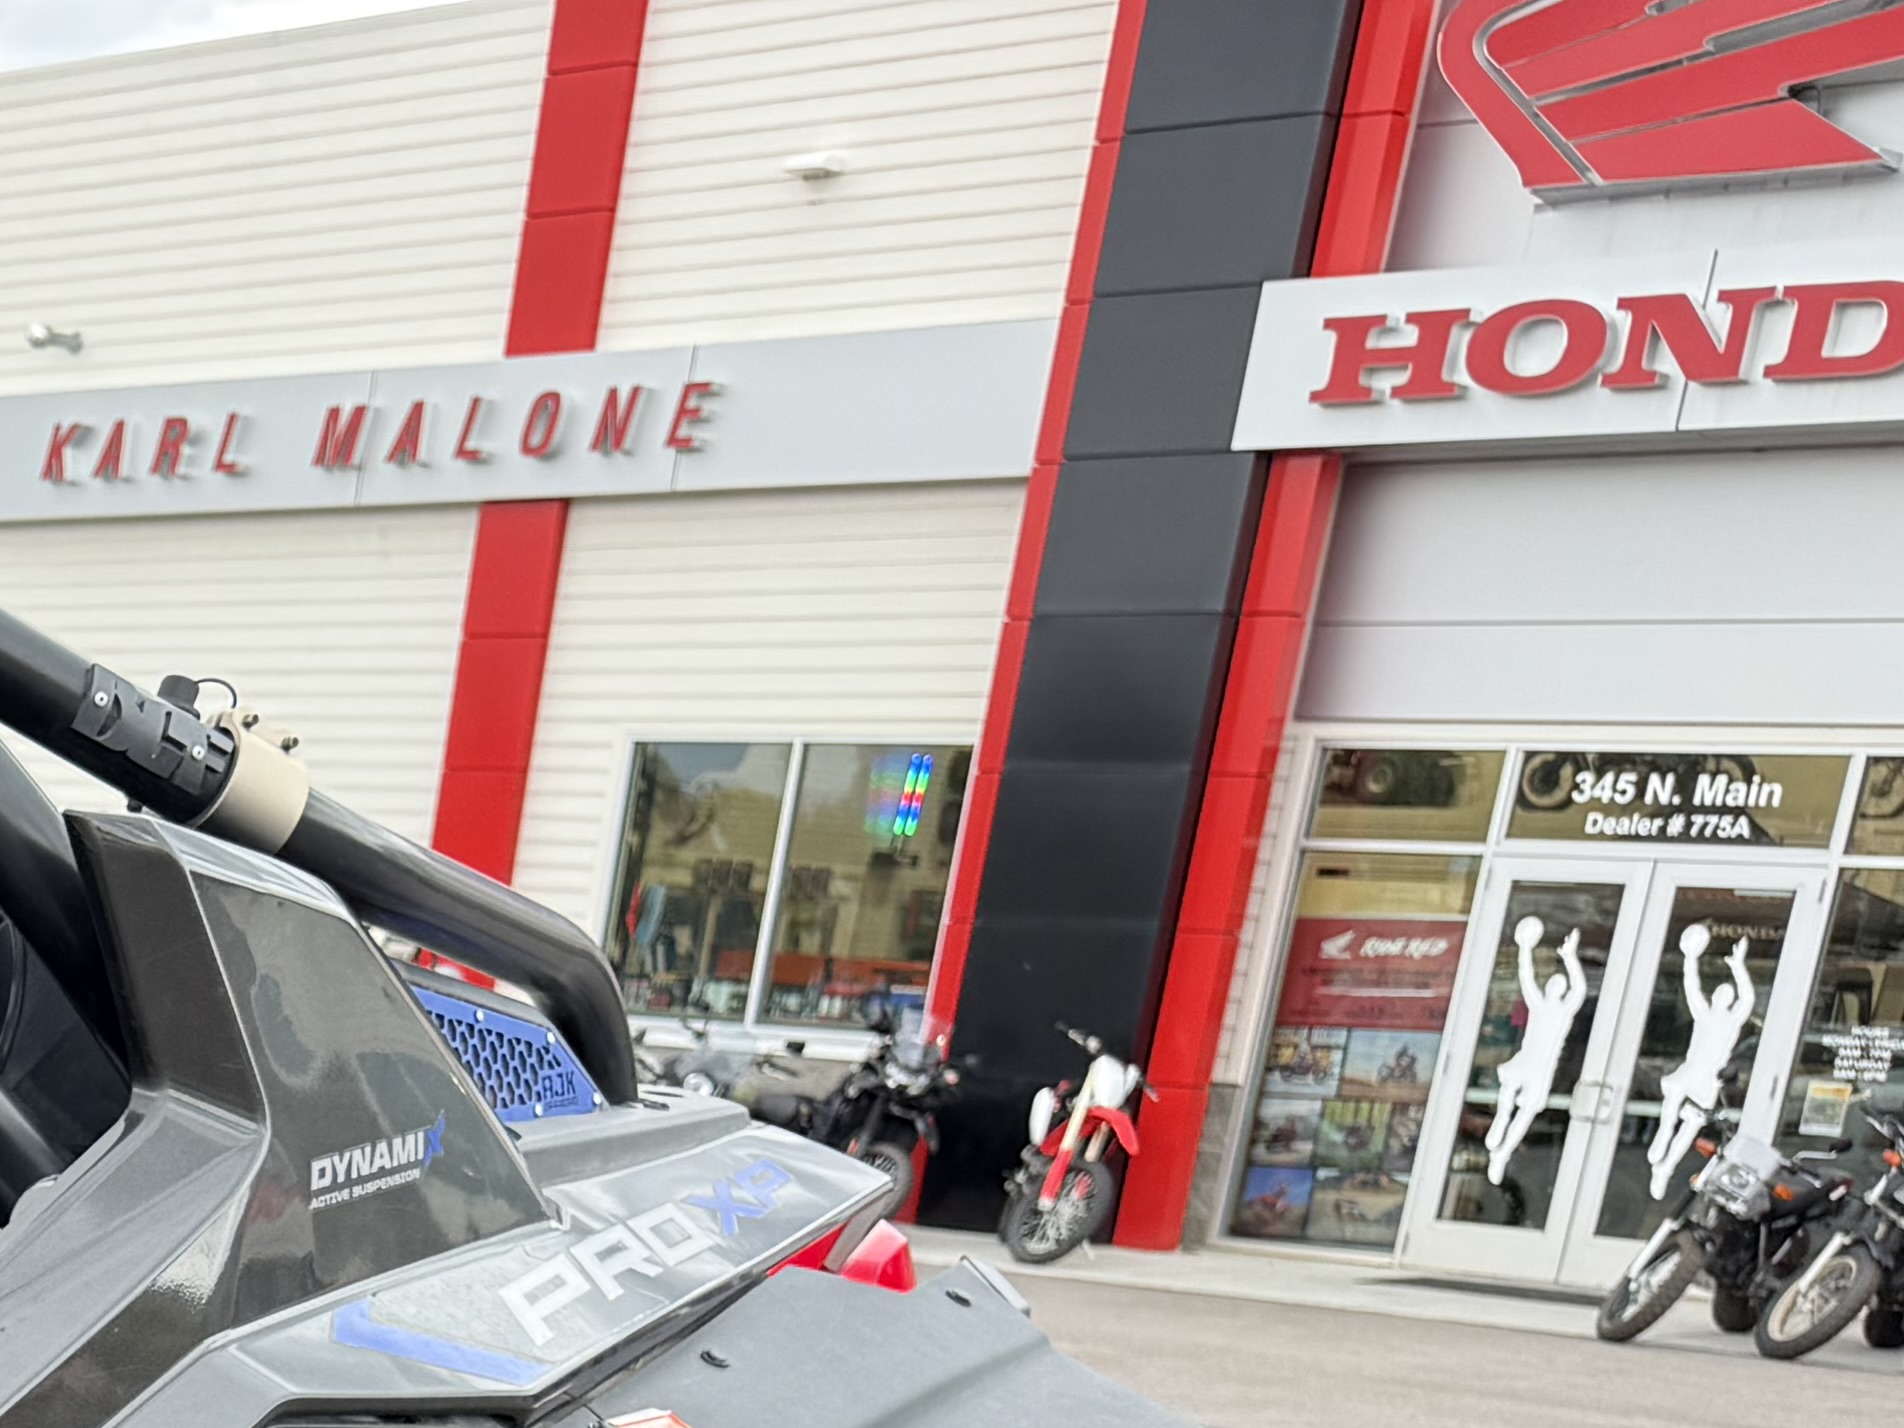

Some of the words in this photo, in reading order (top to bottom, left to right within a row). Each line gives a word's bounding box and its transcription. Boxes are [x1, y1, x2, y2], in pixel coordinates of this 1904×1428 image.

[40, 412, 242, 483] KARL
[311, 382, 716, 468] MALONE
[1571, 771, 1638, 804] 345
[1643, 772, 1682, 806] N.
[1692, 774, 1783, 808] Main
[1583, 811, 1664, 837] Dealer
[1665, 813, 1686, 837] #
[1688, 813, 1751, 839] 775A
[310, 1109, 446, 1191] DYNAMIX
[308, 1188, 351, 1210] ACTIVE
[352, 1168, 422, 1198] SUSPENSION
[498, 1202, 714, 1347] PRO
[680, 1158, 793, 1238] XP
